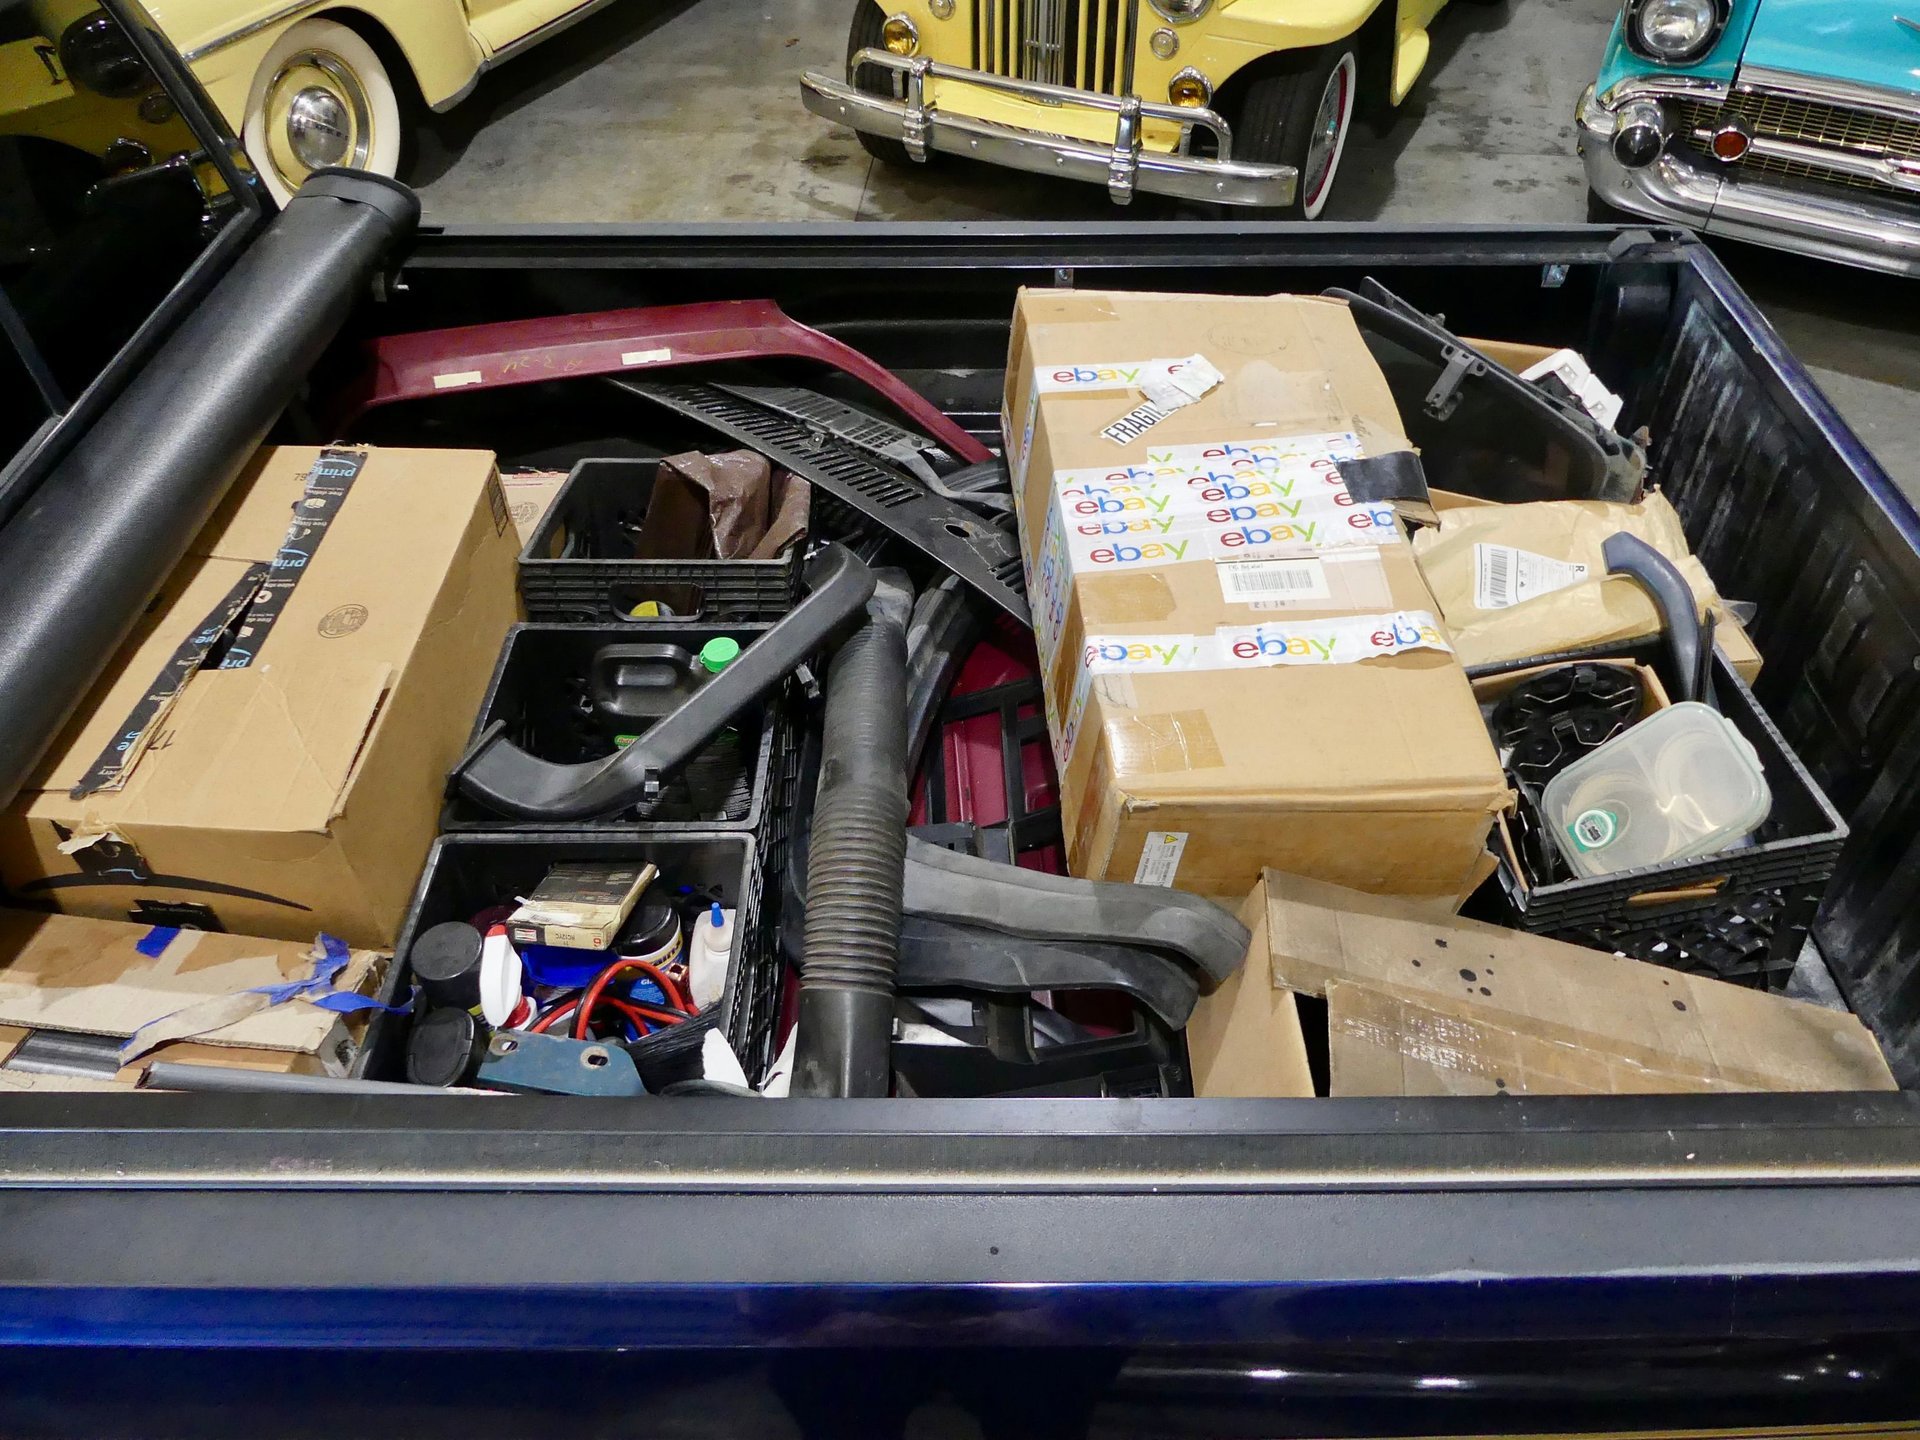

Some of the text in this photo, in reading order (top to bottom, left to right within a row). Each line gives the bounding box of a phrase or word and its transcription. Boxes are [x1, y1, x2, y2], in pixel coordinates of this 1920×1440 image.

[1053, 367, 1140, 384] ebay
[1202, 479, 1294, 501] ebay
[1075, 494, 1170, 514] ebay
[1220, 521, 1316, 547] ebay
[1090, 540, 1189, 563] ebay
[1085, 615, 1441, 669] ebay ebay eba
[217, 656, 250, 669] pri
